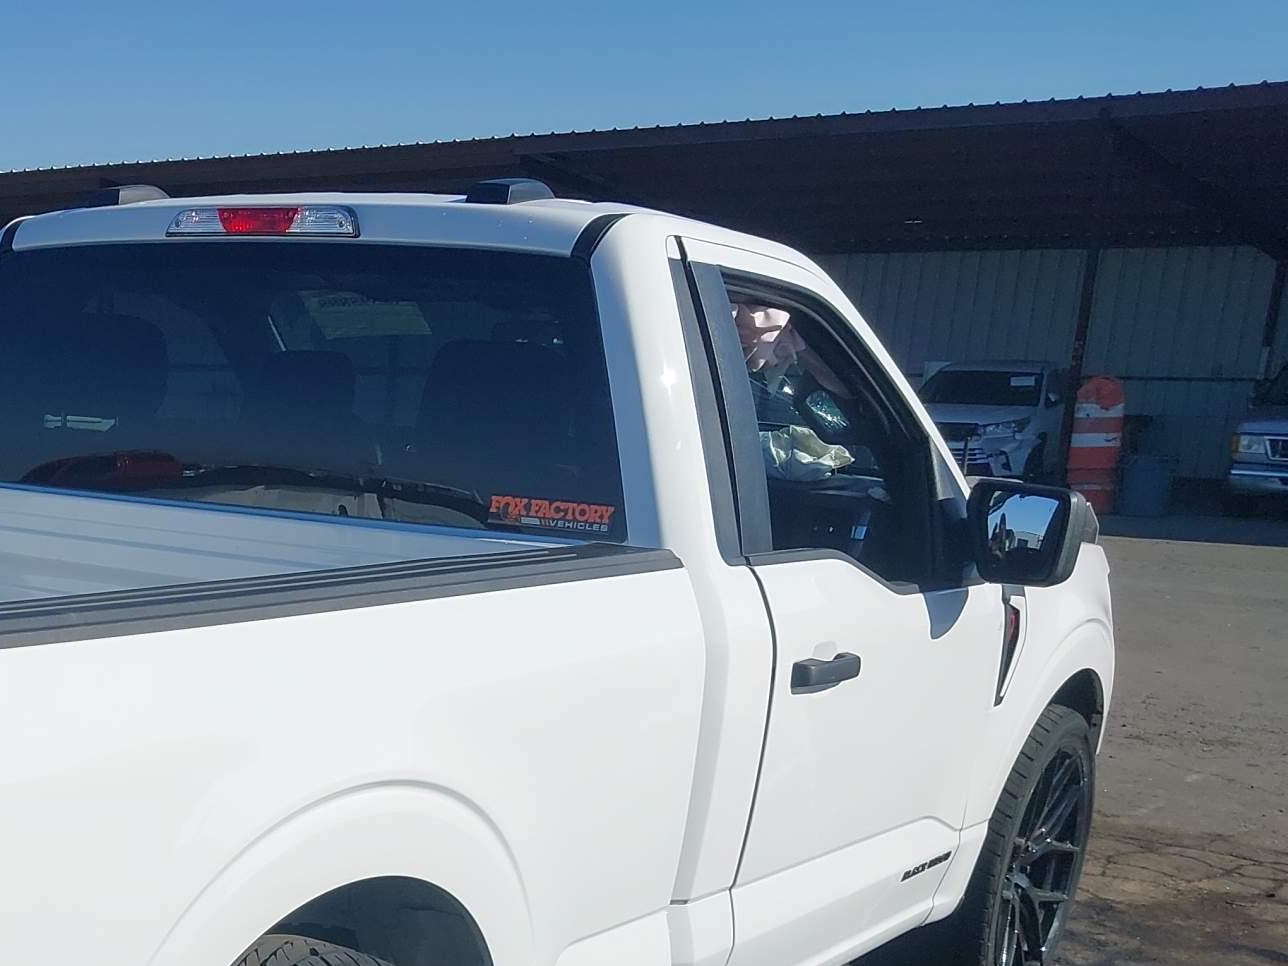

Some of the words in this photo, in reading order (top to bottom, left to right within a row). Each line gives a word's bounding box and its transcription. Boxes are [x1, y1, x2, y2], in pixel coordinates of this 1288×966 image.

[489, 496, 529, 516] FOX
[530, 500, 615, 523] FACTORY
[549, 519, 608, 532] VEHICLES
